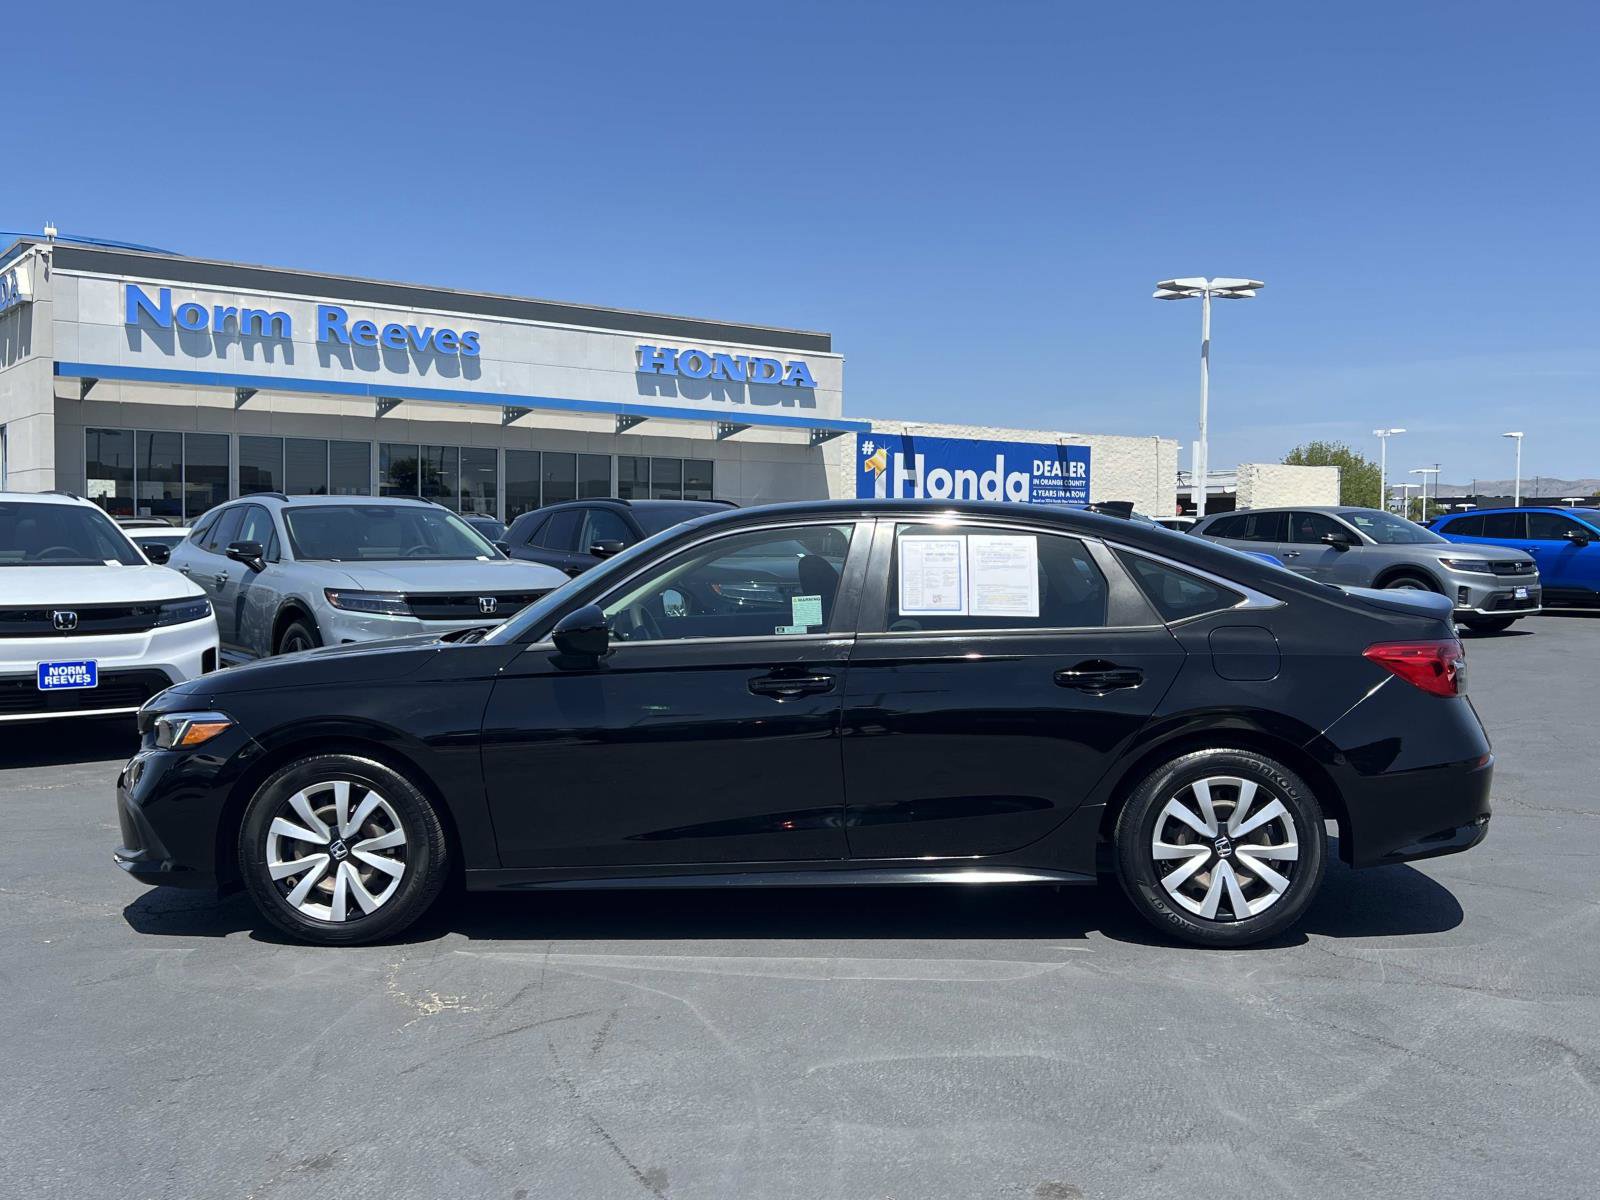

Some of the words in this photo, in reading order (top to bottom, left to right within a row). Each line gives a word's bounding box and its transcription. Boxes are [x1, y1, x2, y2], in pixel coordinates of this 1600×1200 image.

[125, 284, 292, 338] Norm
[315, 304, 481, 356] Reeves
[636, 344, 818, 388] HONDA
[894, 452, 1030, 502] Honda
[1033, 459, 1086, 478] DEALER
[1032, 489, 1037, 497] 4
[1038, 490, 1057, 498] YEARS
[1058, 490, 1065, 498] IN
[44, 674, 91, 685] REEVES
[49, 665, 86, 676] NORM
